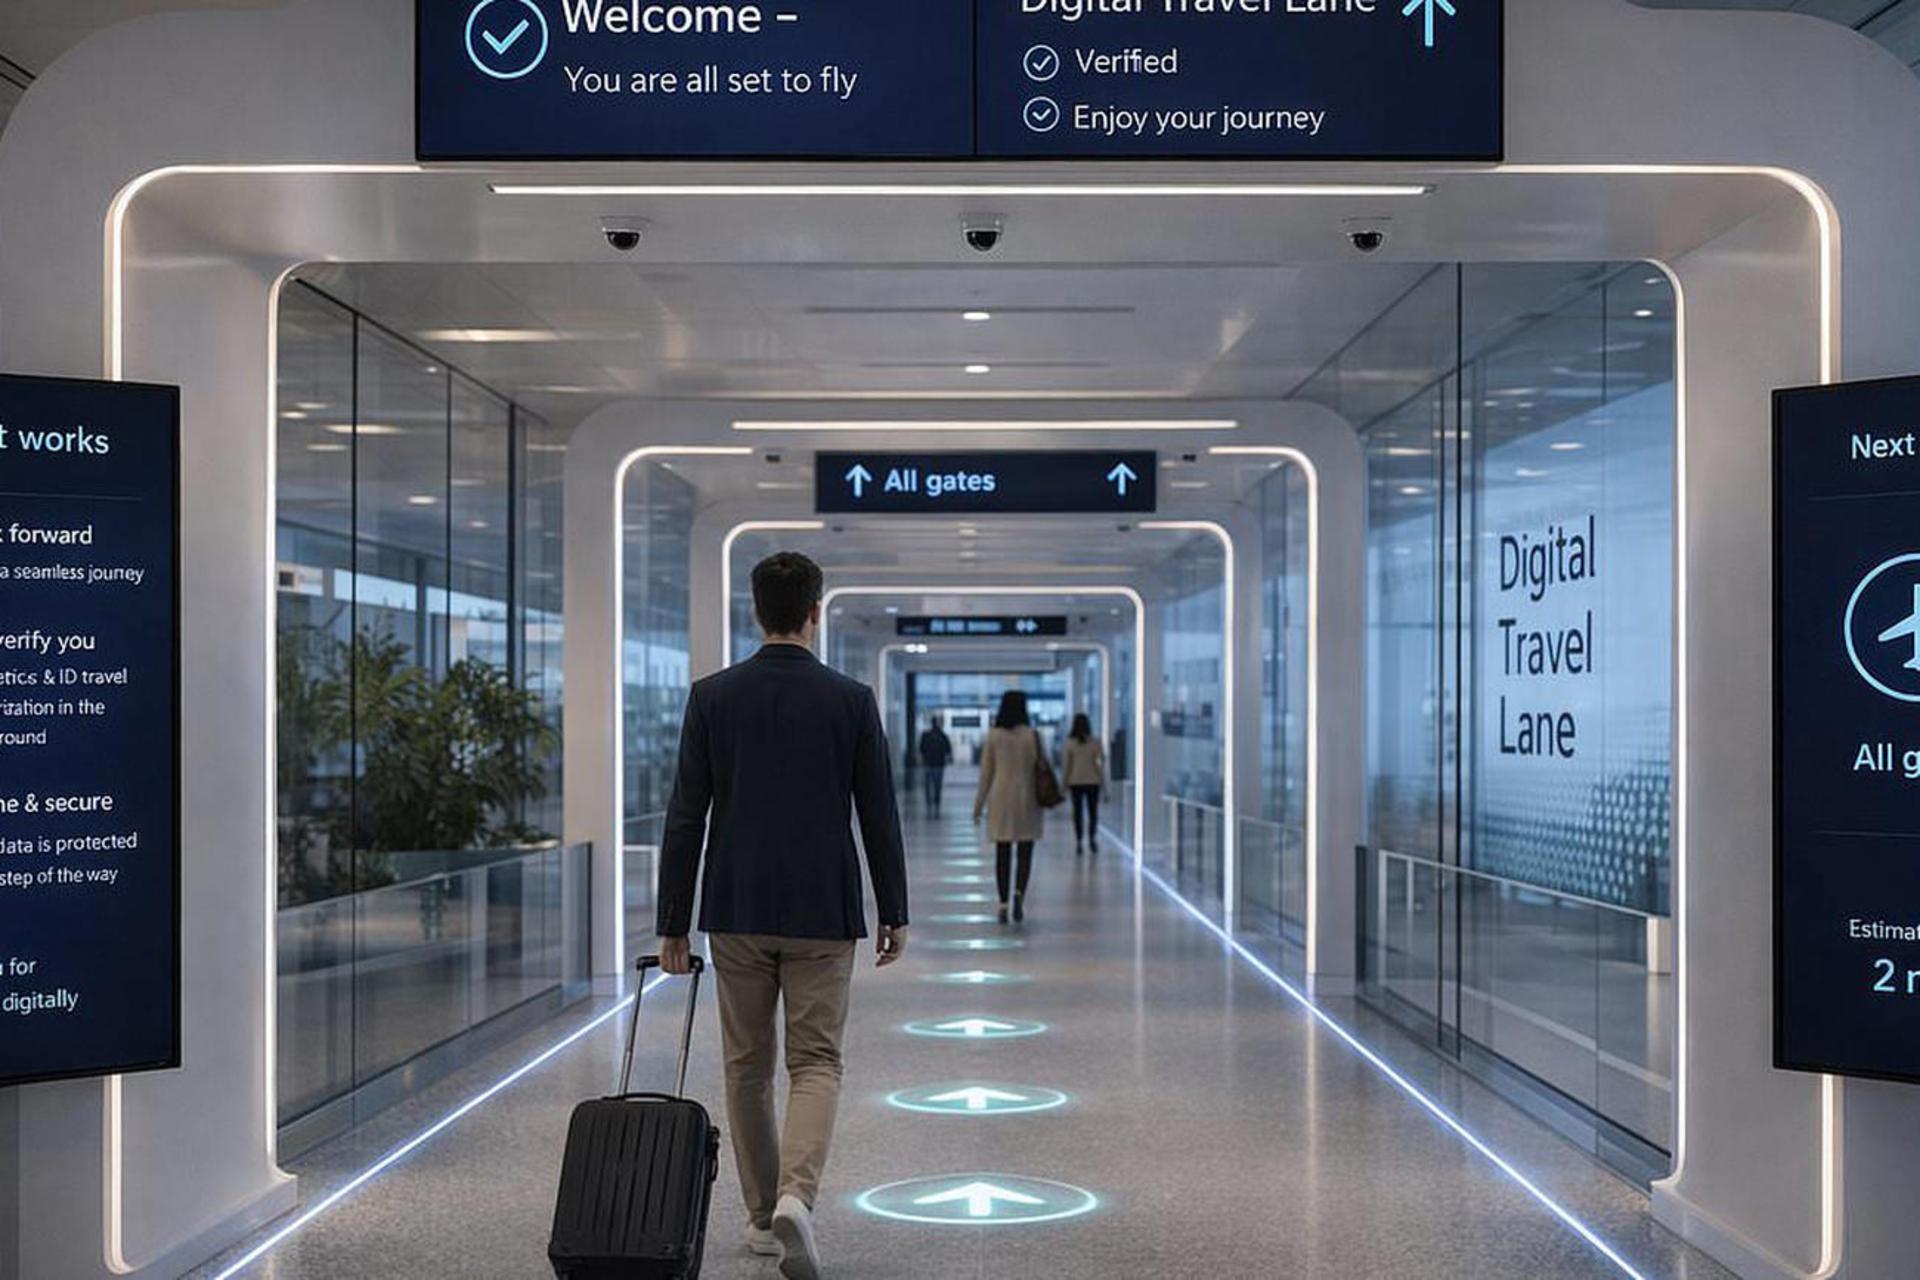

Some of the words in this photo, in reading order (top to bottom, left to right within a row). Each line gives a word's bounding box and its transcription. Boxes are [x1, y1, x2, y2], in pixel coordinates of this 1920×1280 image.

[562, 0, 761, 32] Welcome
[1076, 49, 1177, 73] Verified
[564, 66, 620, 92] You
[631, 73, 677, 93] are
[687, 65, 717, 92] all
[729, 69, 772, 92] set
[781, 70, 811, 92] to
[820, 66, 857, 99] fly
[1075, 105, 1148, 135] Enjoy
[1156, 111, 1216, 135] your
[1221, 106, 1324, 135] journey
[19, 426, 109, 453] works
[1852, 433, 1915, 459] Next
[885, 469, 916, 491] All
[926, 472, 995, 496] gates
[9, 523, 92, 544] forward
[1501, 515, 1595, 602] Digital
[14, 564, 84, 579] seamless
[58, 635, 94, 654] you
[1498, 610, 1591, 675] Travel
[43, 669, 55, 685] &
[60, 668, 77, 684] ID
[82, 668, 127, 684] travel
[59, 699, 73, 714] in
[79, 699, 105, 714] the
[1500, 696, 1575, 758] Lane
[1854, 743, 1892, 770] All
[25, 793, 38, 812] &
[45, 796, 112, 812] secure
[38, 836, 51, 852] is
[56, 832, 137, 855] protected
[0, 872, 33, 888] step
[37, 867, 53, 883] of
[58, 868, 83, 882] the
[87, 869, 118, 884] way
[10, 957, 36, 975] for
[1874, 959, 1895, 991] 2
[3, 989, 78, 1014] digitally
